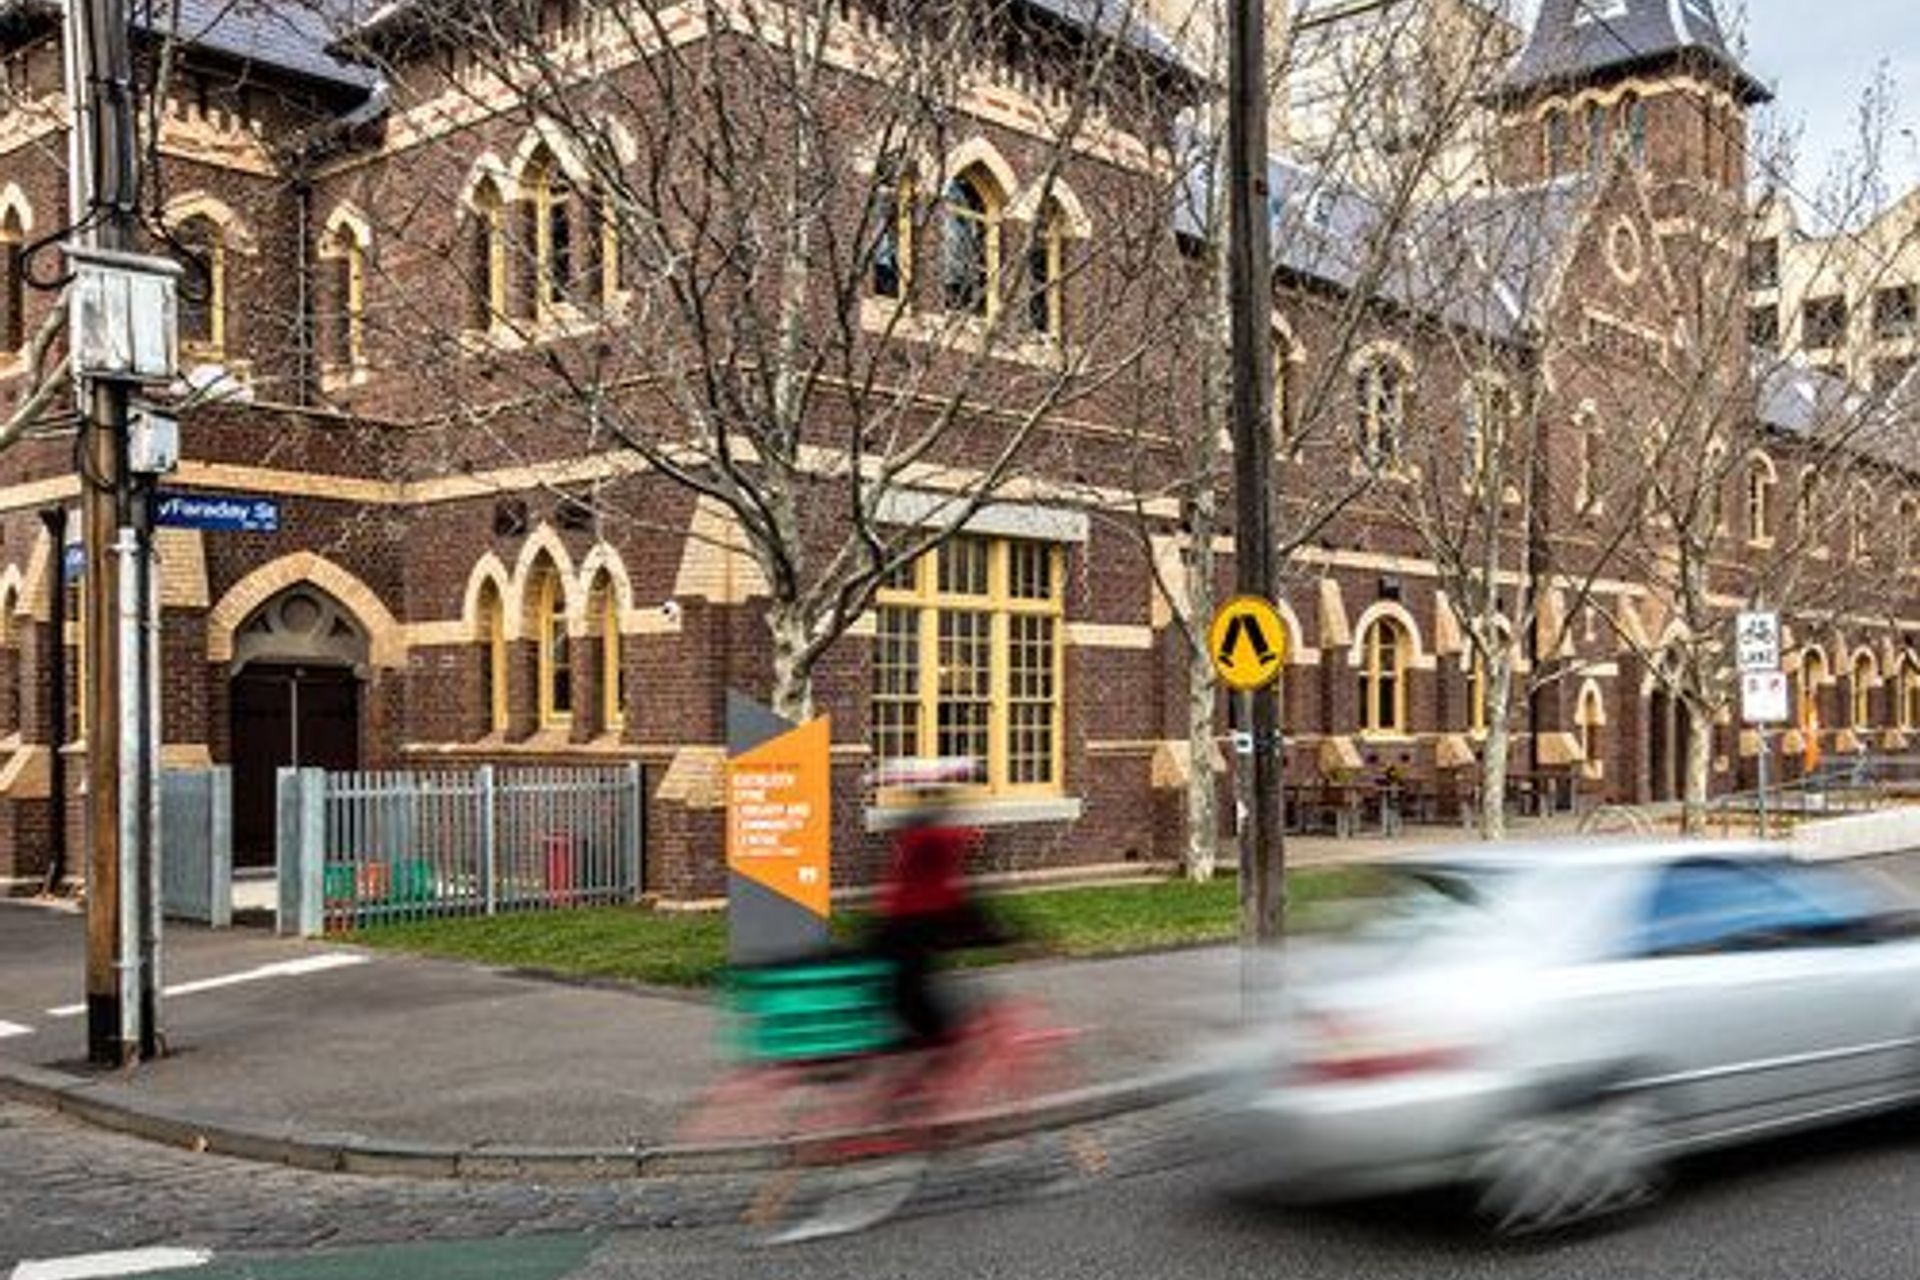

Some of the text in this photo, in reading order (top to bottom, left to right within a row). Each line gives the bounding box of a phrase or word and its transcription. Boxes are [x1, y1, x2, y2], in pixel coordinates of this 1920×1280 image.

[171, 498, 276, 523] Faraday St
[1740, 649, 1774, 663] LANE
